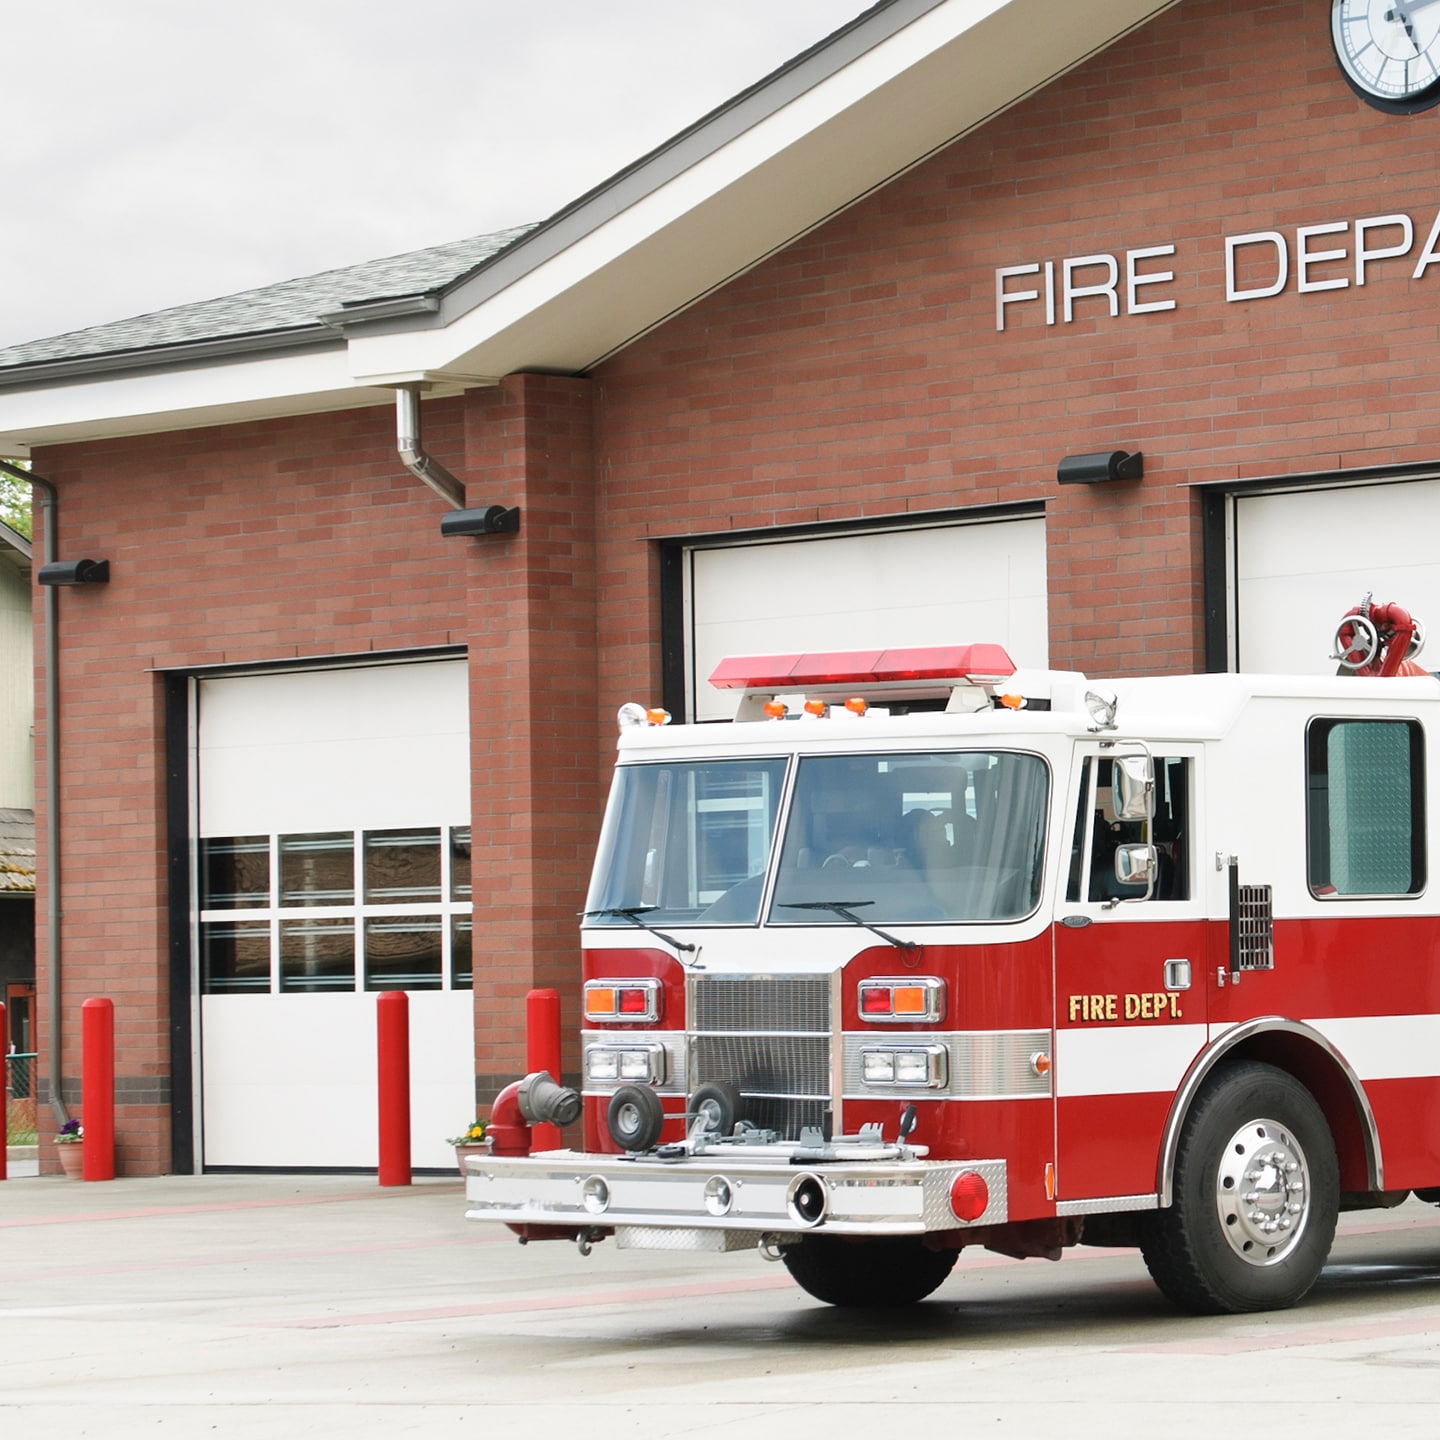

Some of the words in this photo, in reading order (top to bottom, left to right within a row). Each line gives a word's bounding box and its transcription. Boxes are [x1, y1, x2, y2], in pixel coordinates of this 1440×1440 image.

[995, 245, 1176, 332] FIRE
[1069, 995, 1118, 1021] FIRE
[1124, 992, 1182, 1019] DEPT.
